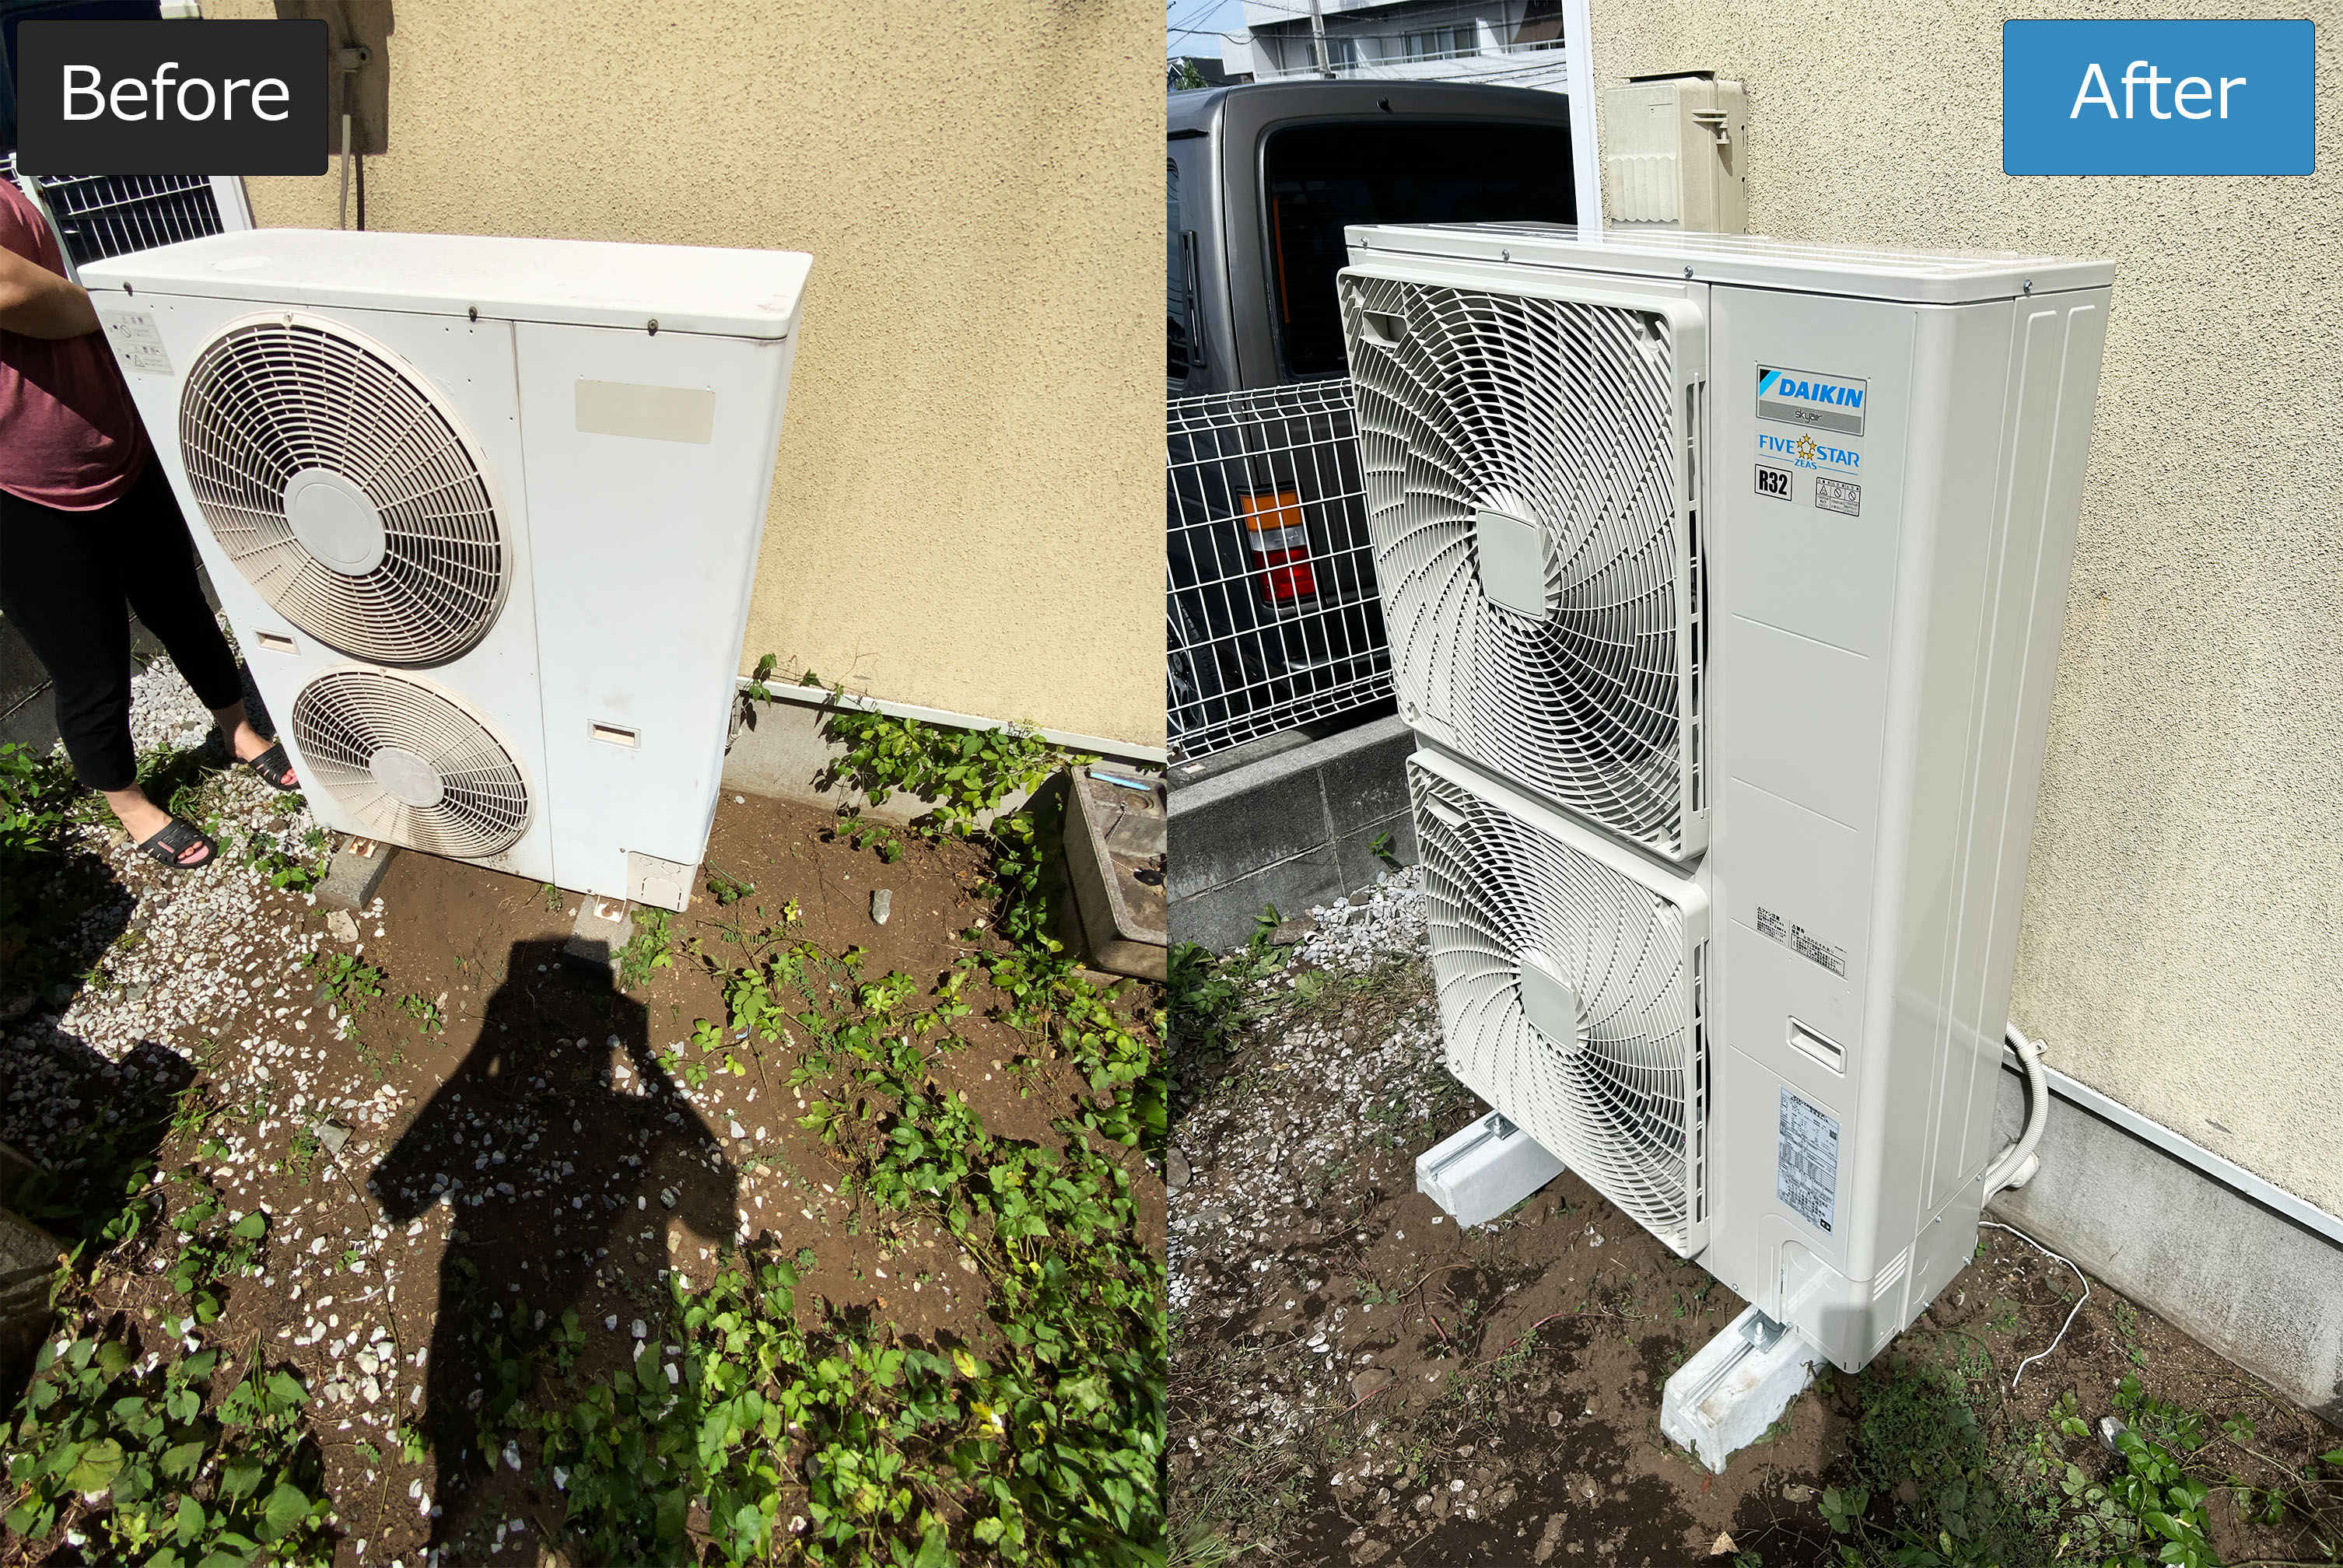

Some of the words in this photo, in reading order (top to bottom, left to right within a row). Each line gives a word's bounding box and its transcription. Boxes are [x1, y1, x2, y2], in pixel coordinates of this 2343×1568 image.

[1778, 378, 1864, 408] DAIKIN
[1759, 434, 1795, 455] FIVE
[1816, 446, 1860, 468] STAR
[1794, 458, 1818, 471] ZEAS
[1759, 469, 1788, 496] R32
